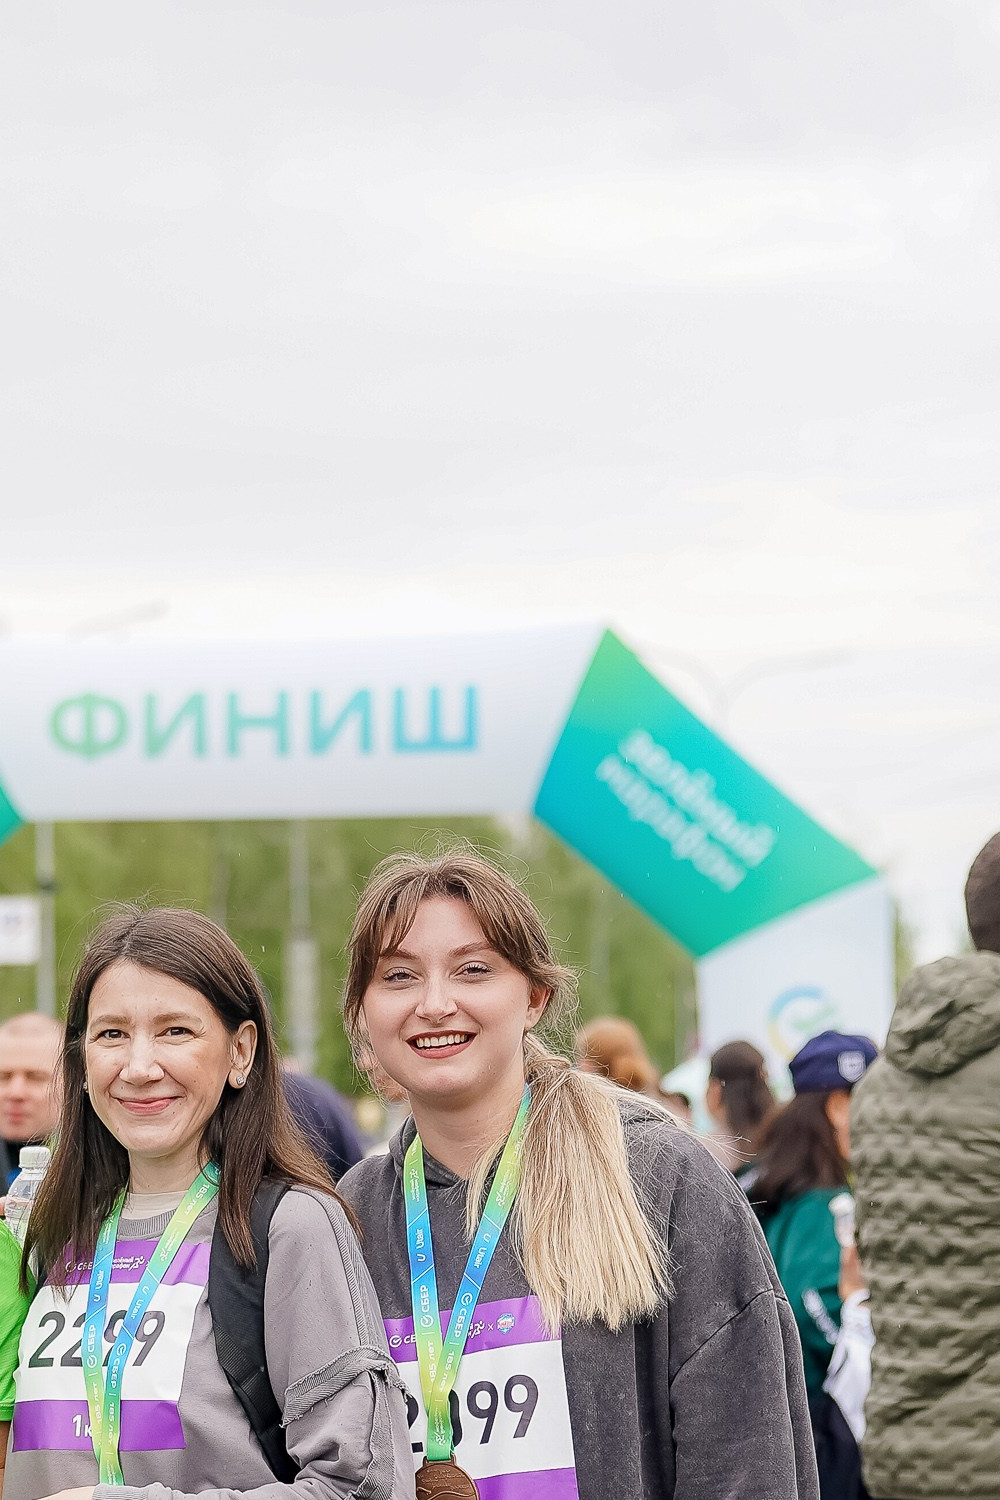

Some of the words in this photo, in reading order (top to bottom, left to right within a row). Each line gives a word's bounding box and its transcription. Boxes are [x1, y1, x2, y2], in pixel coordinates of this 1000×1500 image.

[49, 685, 478, 759] ФИНИШ
[415, 1228, 425, 1249] Utair
[77, 1261, 93, 1271] СБЕ
[474, 1247, 487, 1269] Utair
[95, 1270, 104, 1290] Utair
[131, 1299, 144, 1319] Utair
[420, 1285, 429, 1313] СБЕР
[454, 1308, 467, 1338] СБЕР
[28, 1310, 166, 1369] 2299
[87, 1325, 96, 1353] СБЕР
[111, 1358, 121, 1389] СБЕР
